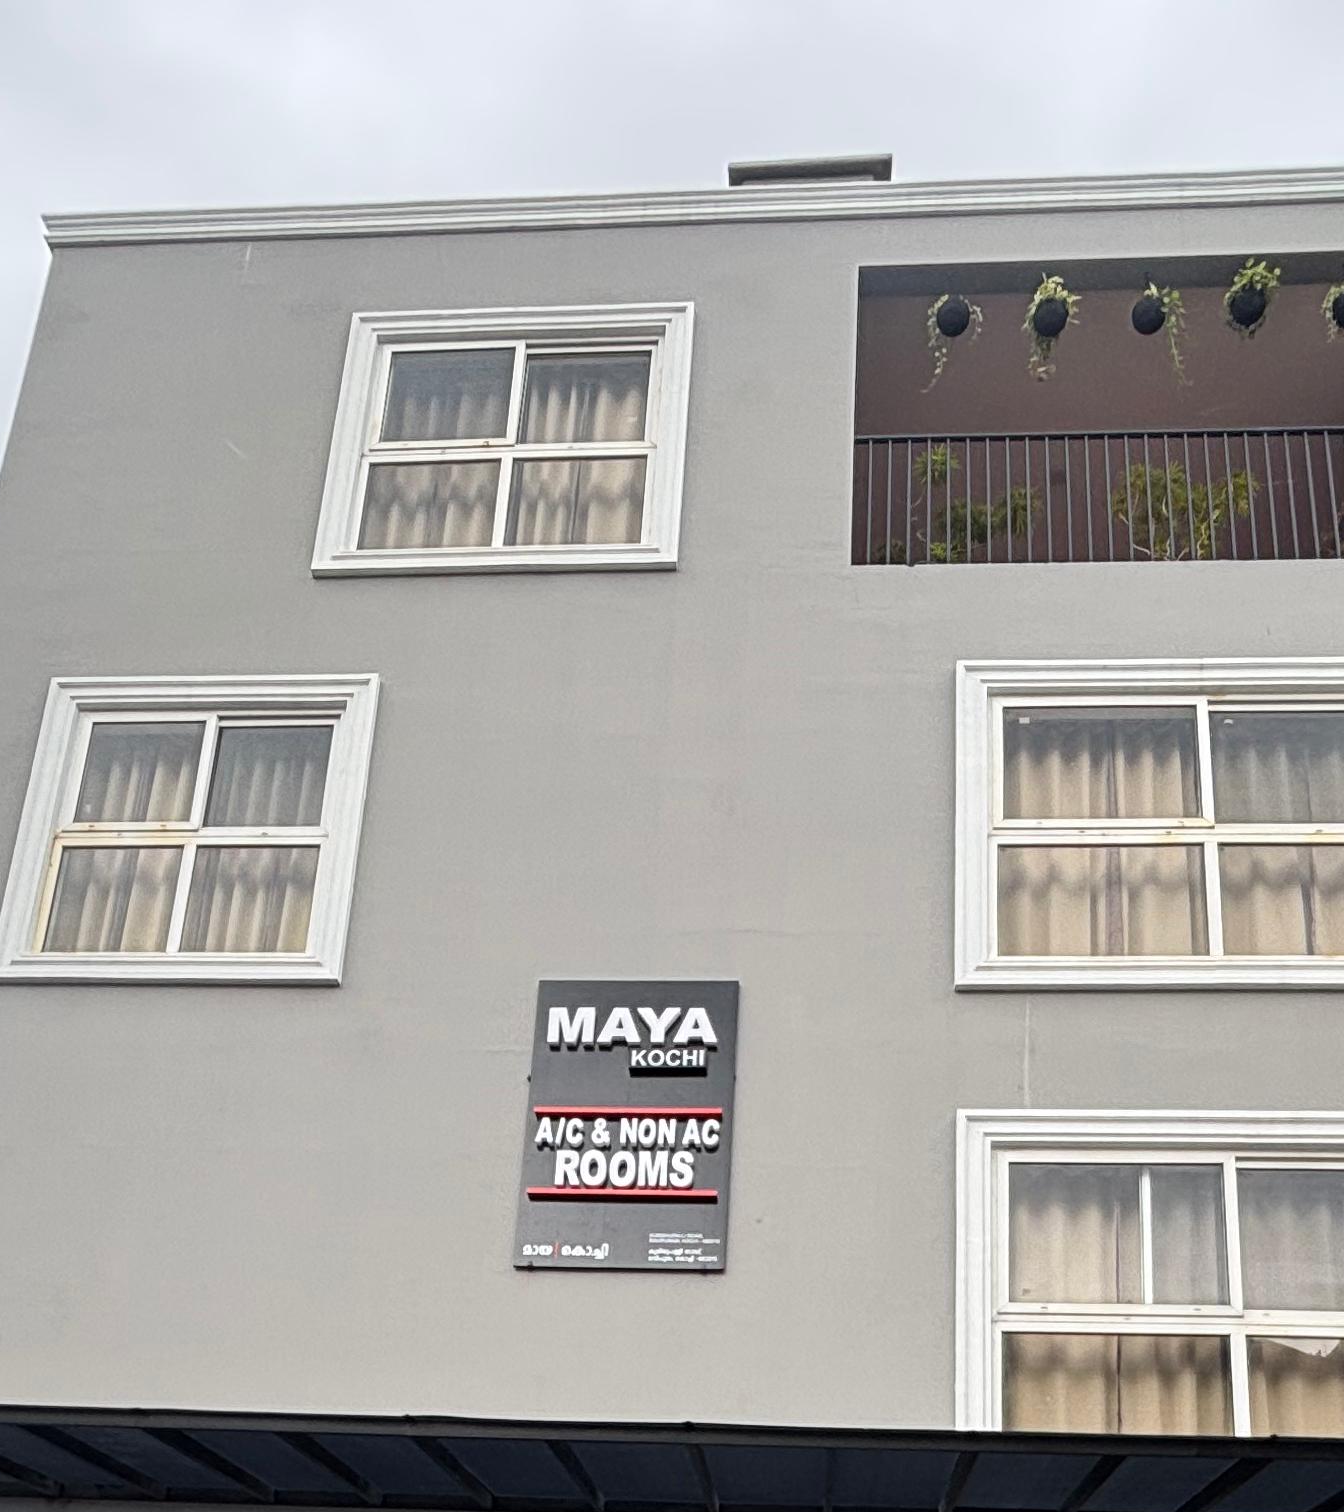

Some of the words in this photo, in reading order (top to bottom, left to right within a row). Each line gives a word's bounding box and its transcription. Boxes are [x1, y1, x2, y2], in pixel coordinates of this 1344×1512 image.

[546, 1006, 718, 1045] MAYA
[630, 1049, 705, 1067] KOCHI
[534, 1116, 585, 1146] A/C
[590, 1117, 611, 1147] &
[619, 1117, 677, 1148] NON
[681, 1118, 721, 1149] AC
[554, 1150, 695, 1189] ROOMS
